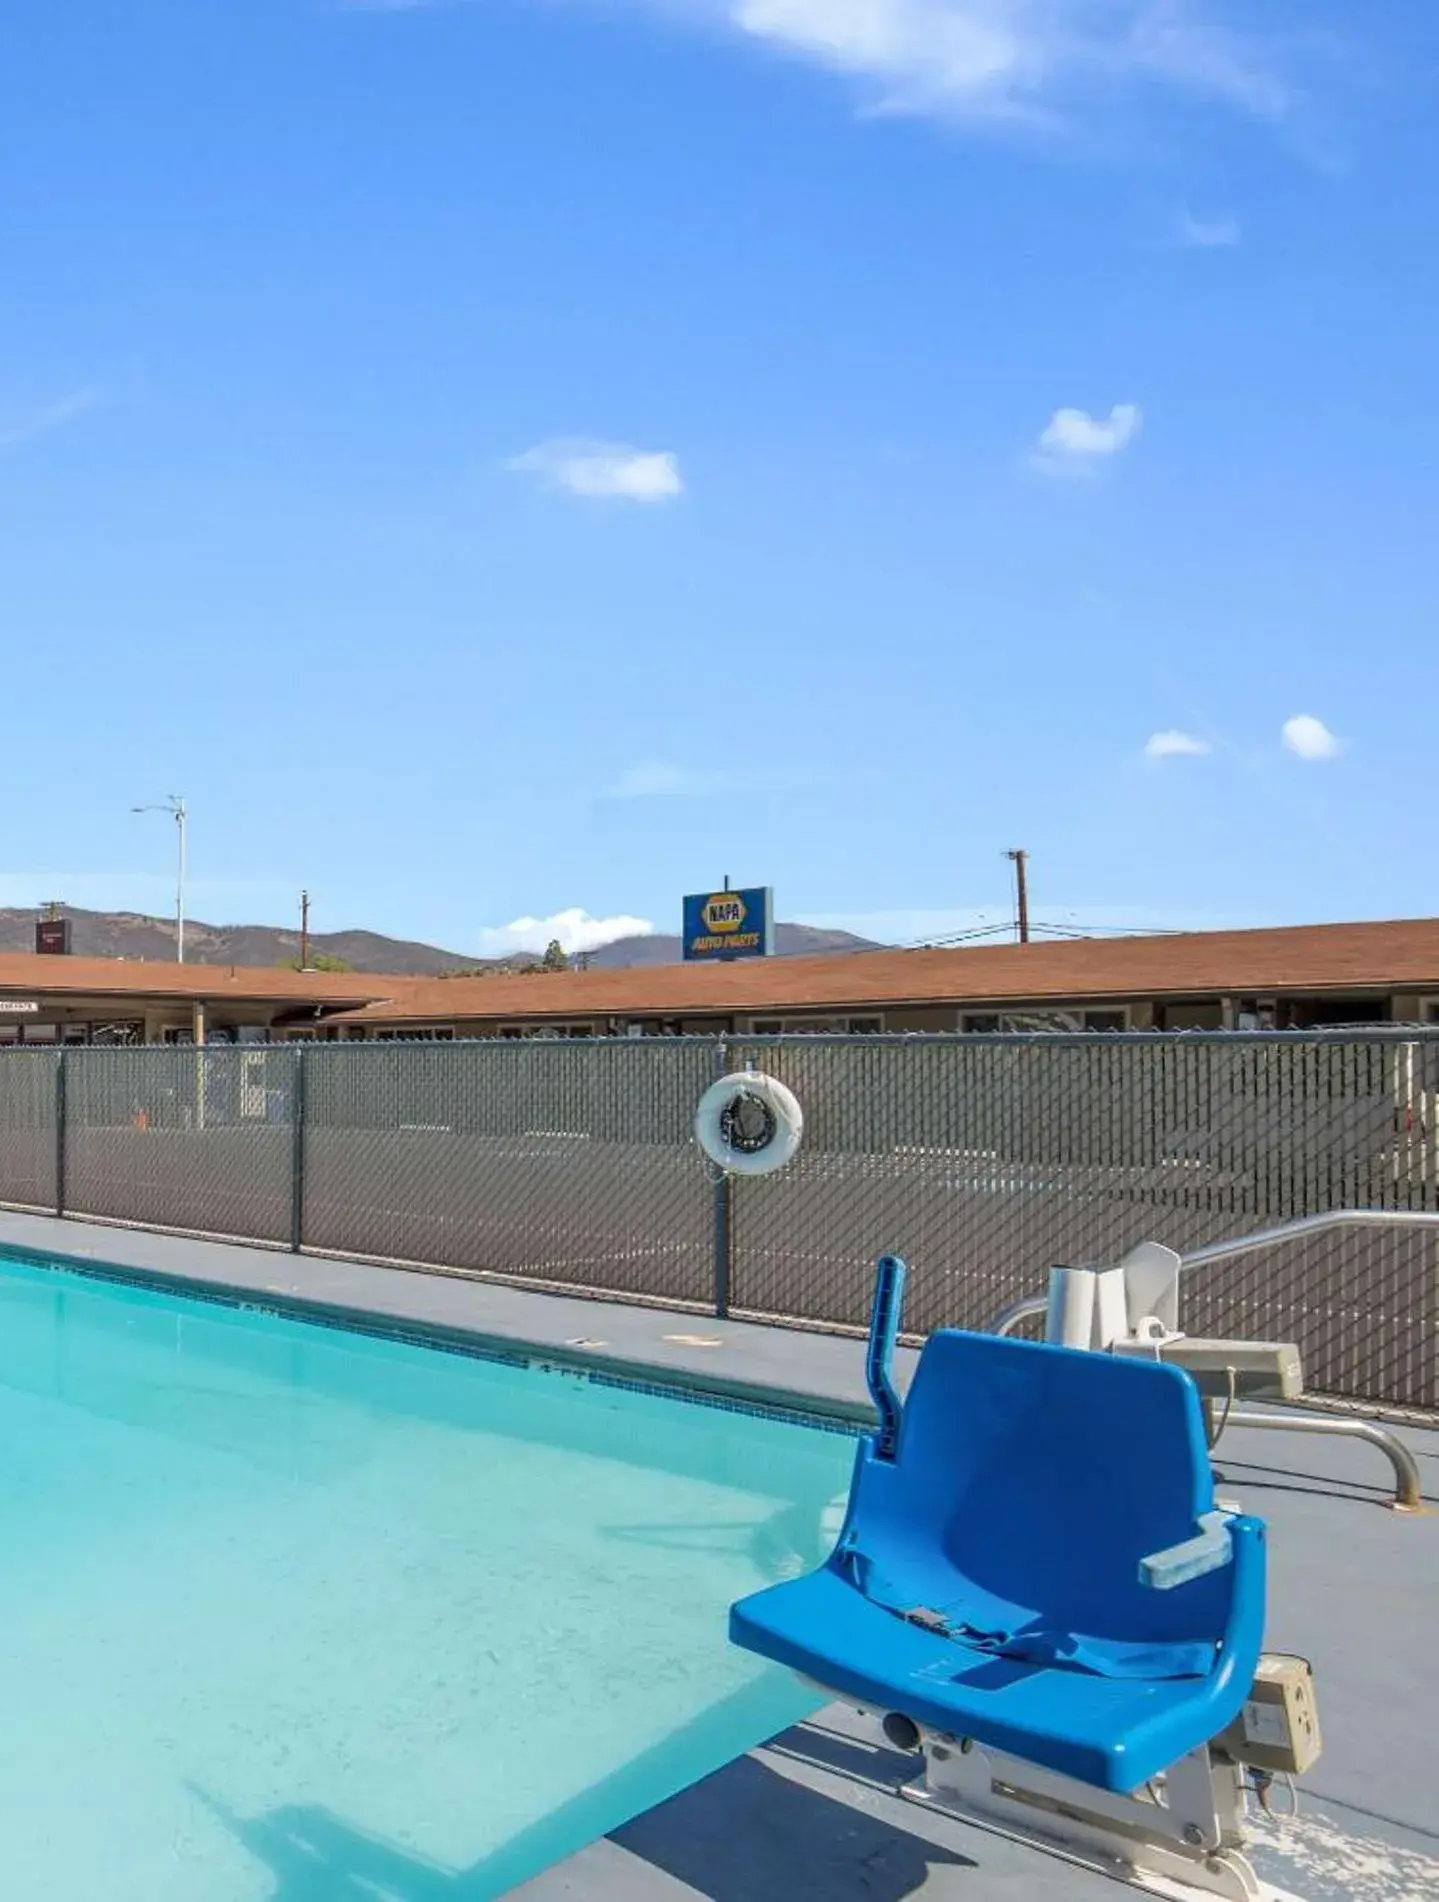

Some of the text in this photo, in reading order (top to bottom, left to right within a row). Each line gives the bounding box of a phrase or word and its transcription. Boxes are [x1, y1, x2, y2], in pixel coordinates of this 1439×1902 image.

[709, 903, 740, 922] NAPA
[692, 932, 760, 951] AUTO PARTS
